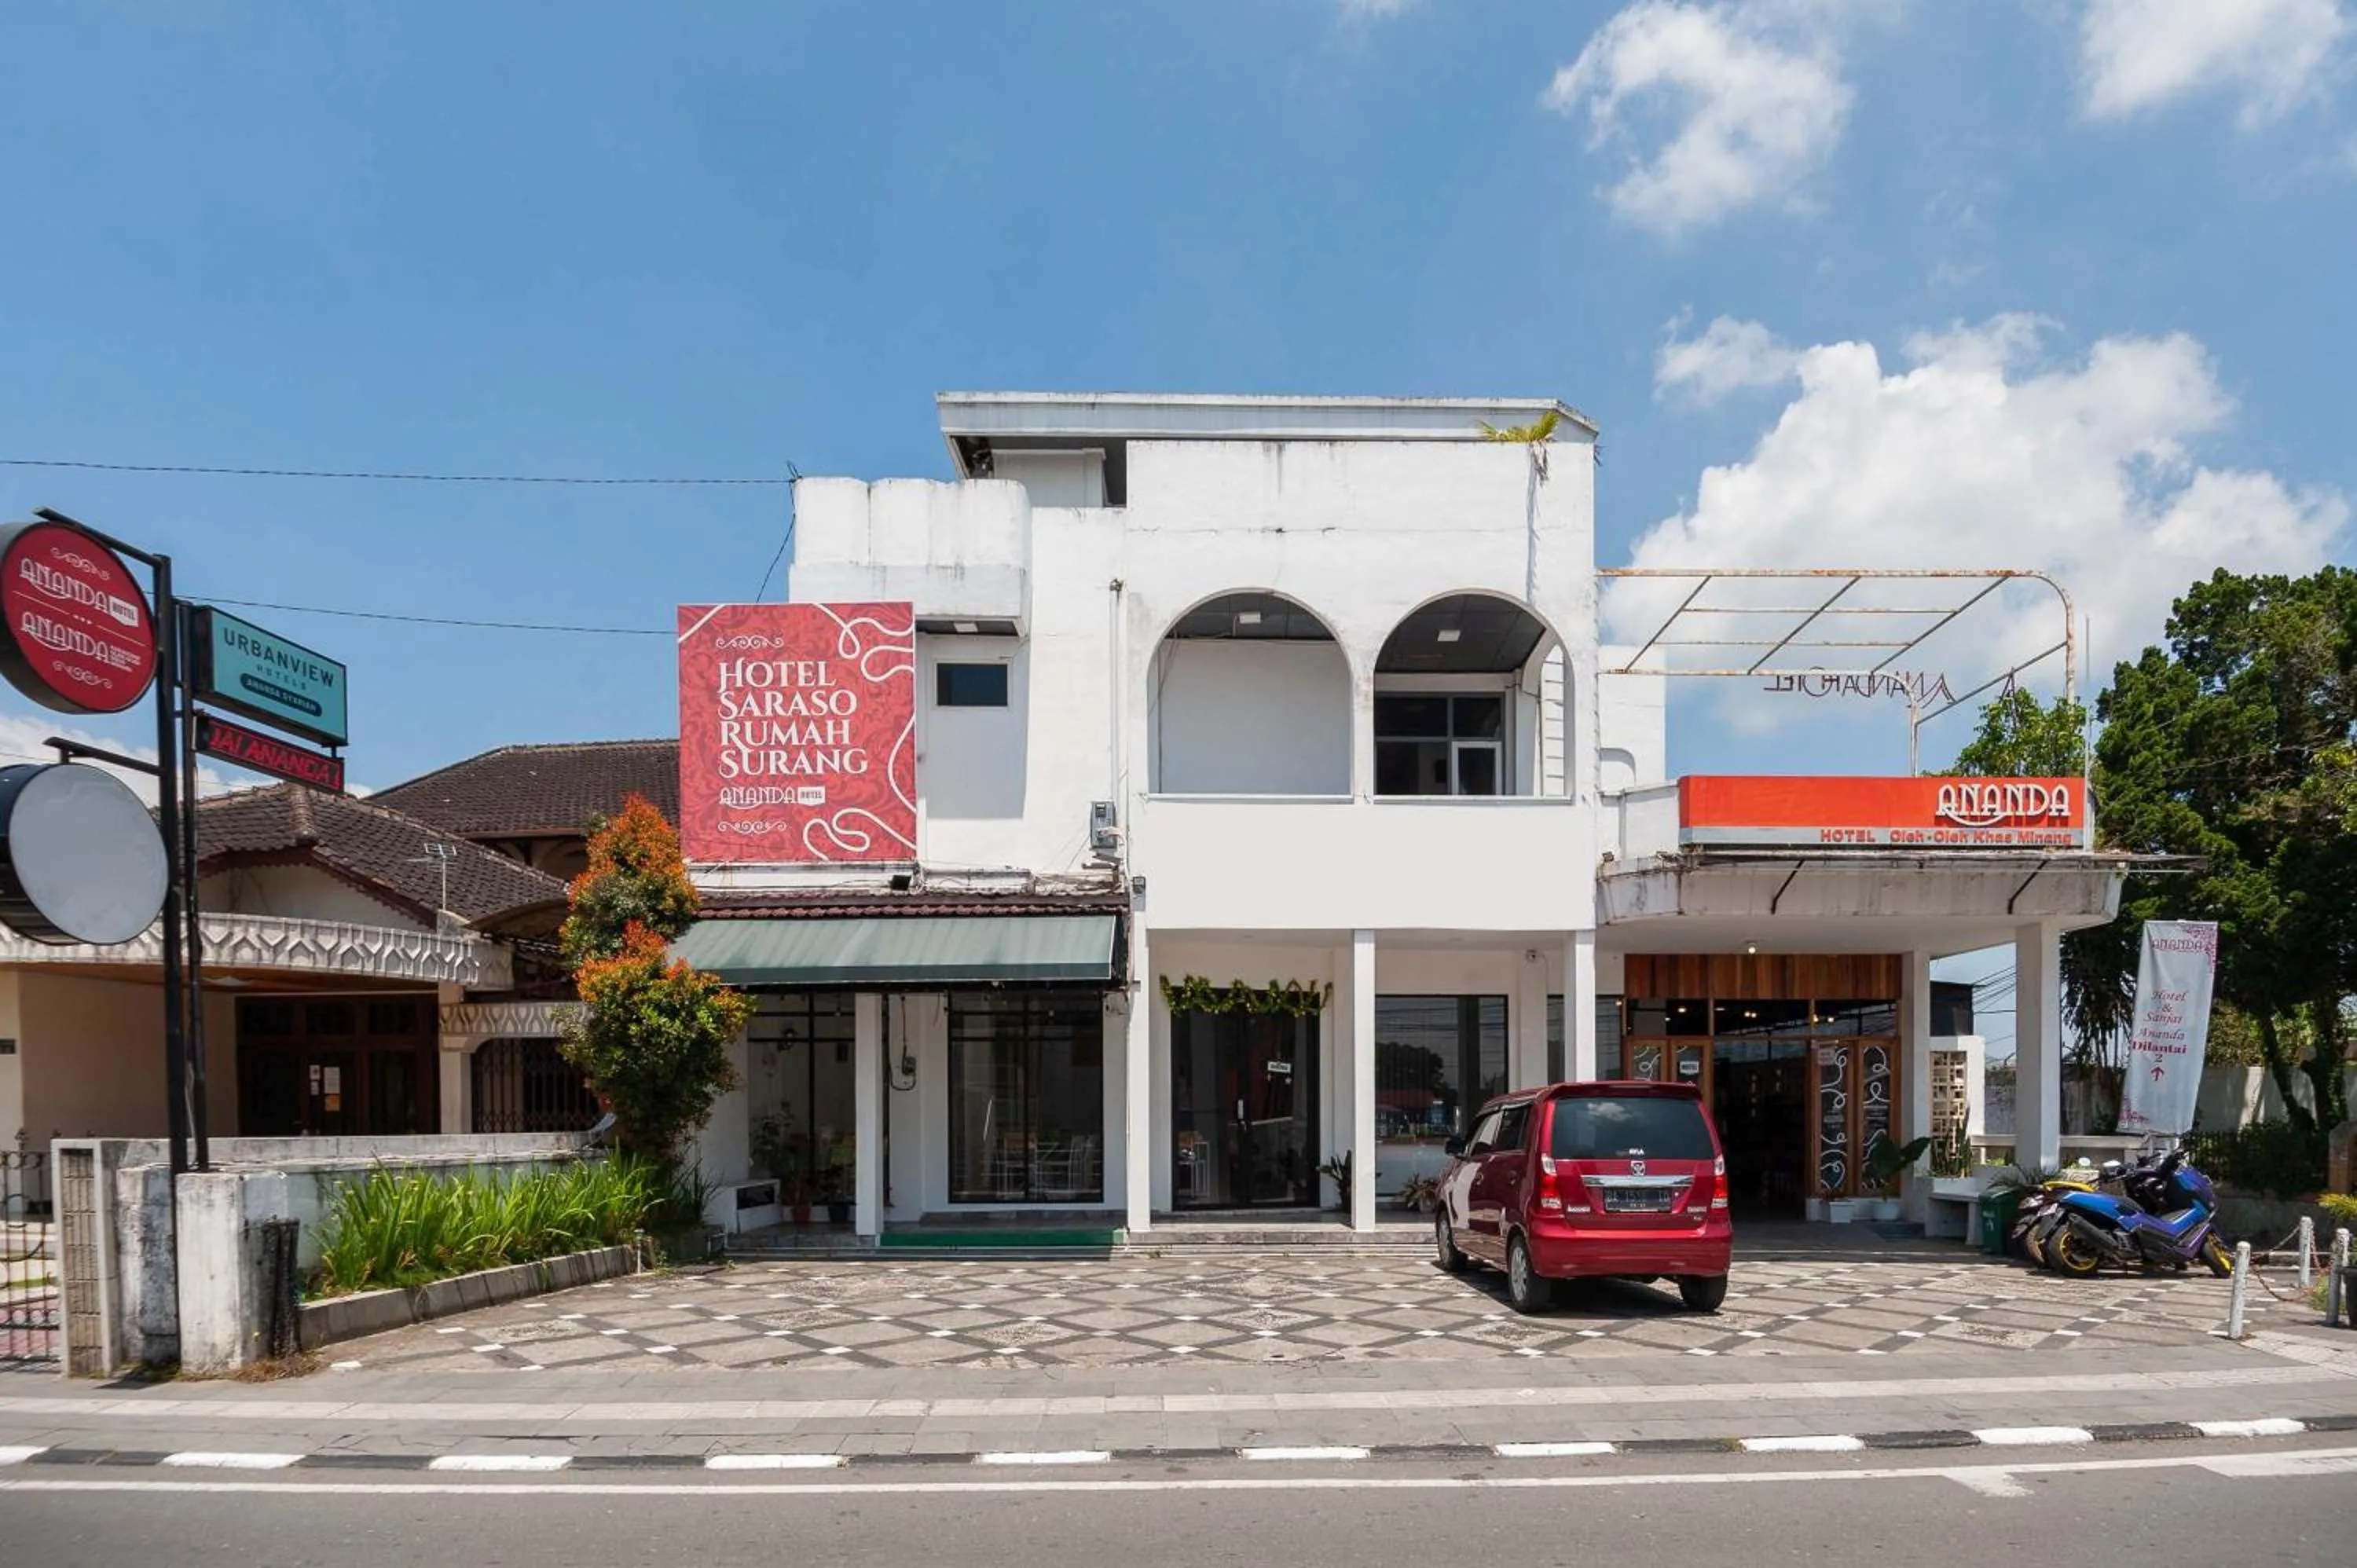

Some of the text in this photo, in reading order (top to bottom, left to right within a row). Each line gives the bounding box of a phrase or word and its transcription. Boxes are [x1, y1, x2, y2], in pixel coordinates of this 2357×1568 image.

[20, 558, 108, 614] ANANDA
[20, 611, 109, 663] ANANDA
[223, 628, 334, 687] URBANVIEW
[256, 665, 306, 690] HOTELS
[717, 658, 837, 694] HOTEL
[717, 689, 857, 720] SARASO
[719, 720, 851, 751] RUMAH
[718, 748, 868, 779] SURANG
[719, 786, 797, 809] ANANDA
[1935, 783, 2072, 826] ANANDA
[1820, 829, 1875, 843] HOTEL
[1973, 830, 2011, 844] Khas
[2017, 830, 2072, 845] Minang
[2151, 991, 2188, 1002] Hotel
[2162, 1003, 2172, 1013] &
[2155, 1053, 2163, 1063] 2
